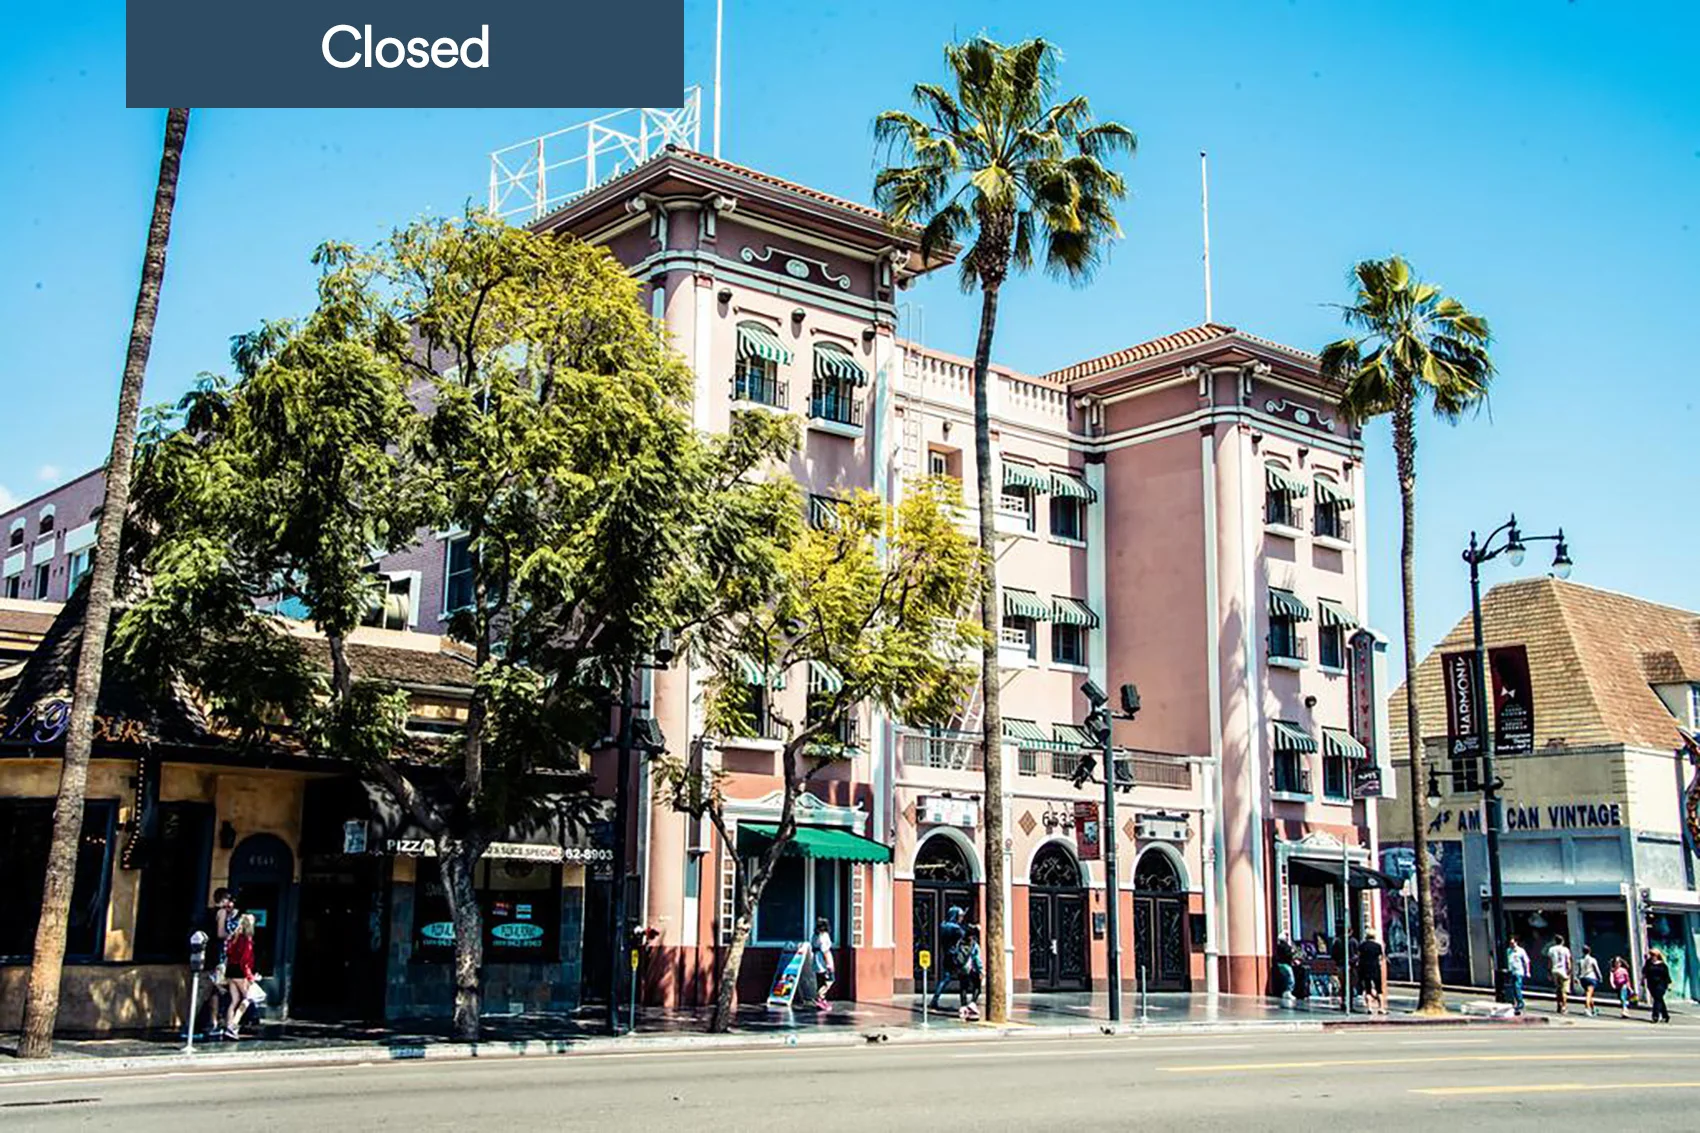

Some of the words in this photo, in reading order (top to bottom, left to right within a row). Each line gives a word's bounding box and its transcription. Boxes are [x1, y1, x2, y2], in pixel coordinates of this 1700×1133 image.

[1456, 657, 1471, 735] HARMONY
[1458, 807, 1539, 831] AMCAN
[1548, 804, 1622, 828] VINTAGE
